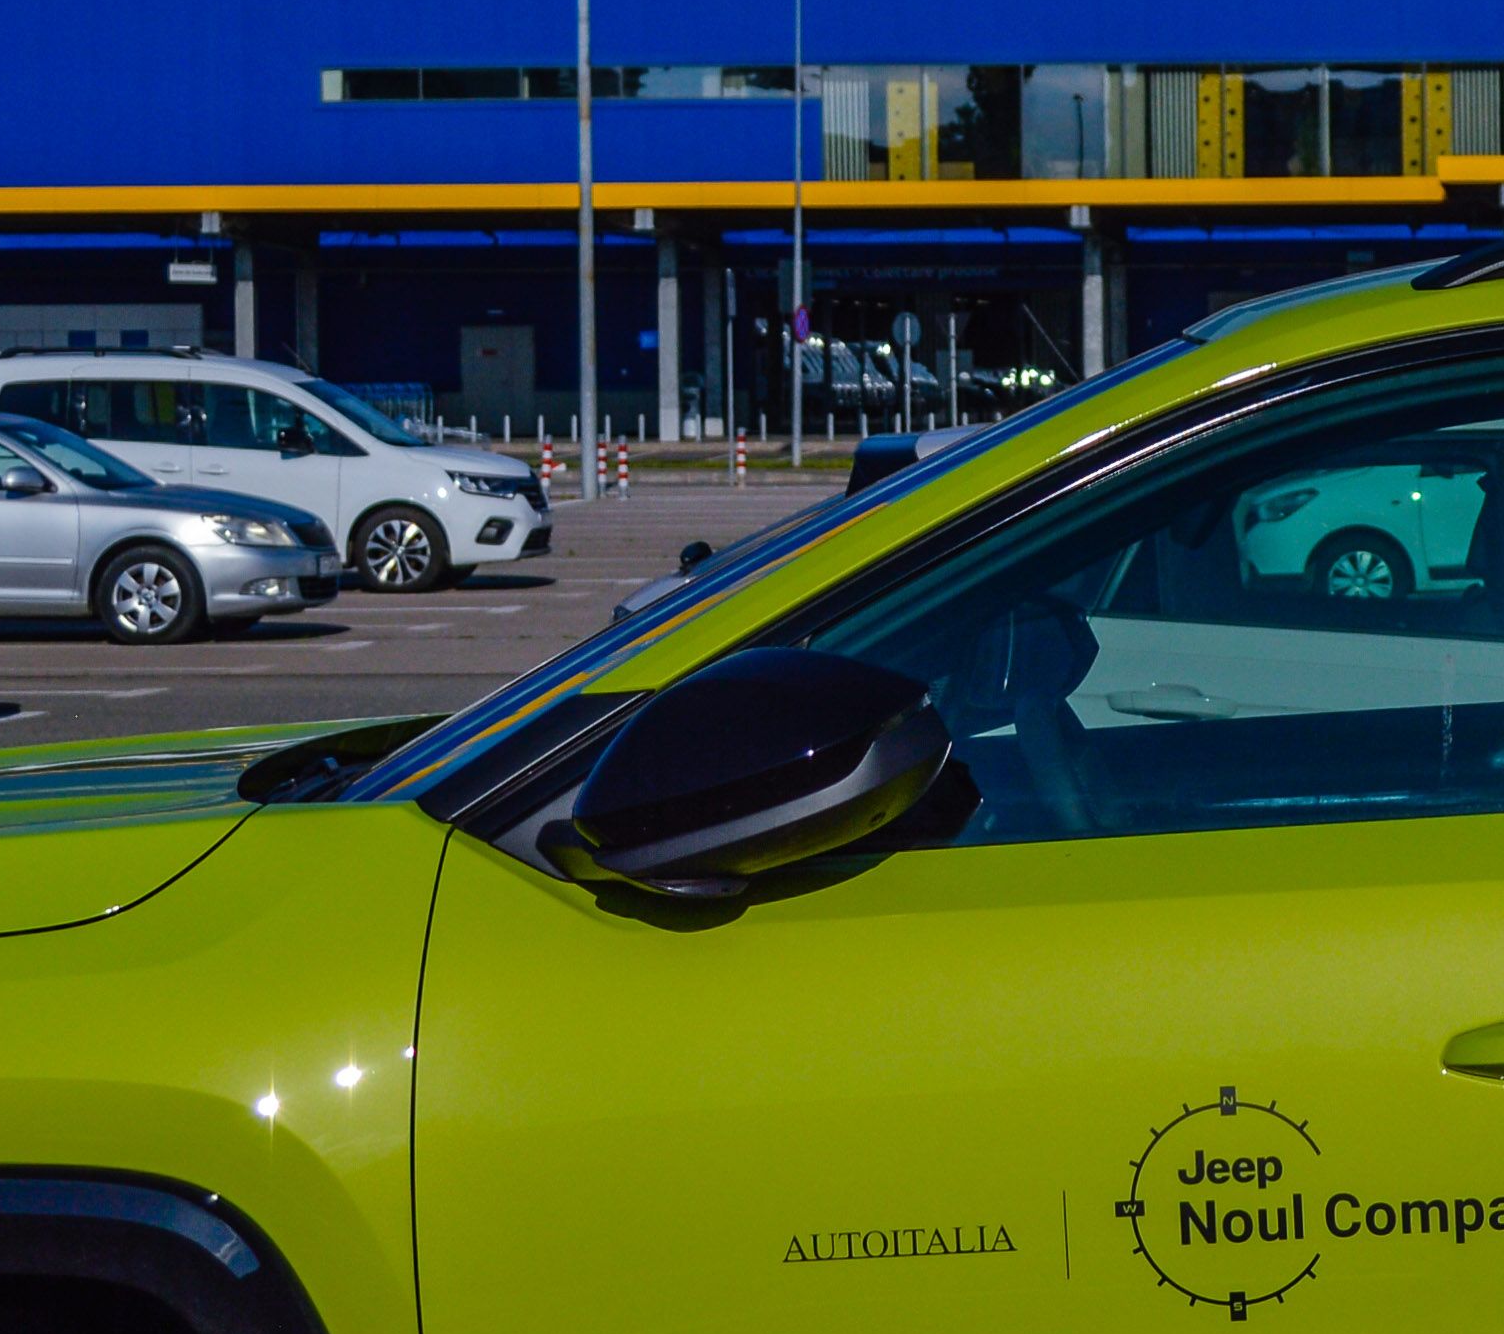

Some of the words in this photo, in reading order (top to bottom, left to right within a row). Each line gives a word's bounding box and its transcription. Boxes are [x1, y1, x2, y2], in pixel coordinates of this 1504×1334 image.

[1178, 1150, 1283, 1189] Jeep
[1179, 1194, 1304, 1246] Noul
[783, 1224, 1018, 1263] AUTOITALIA
